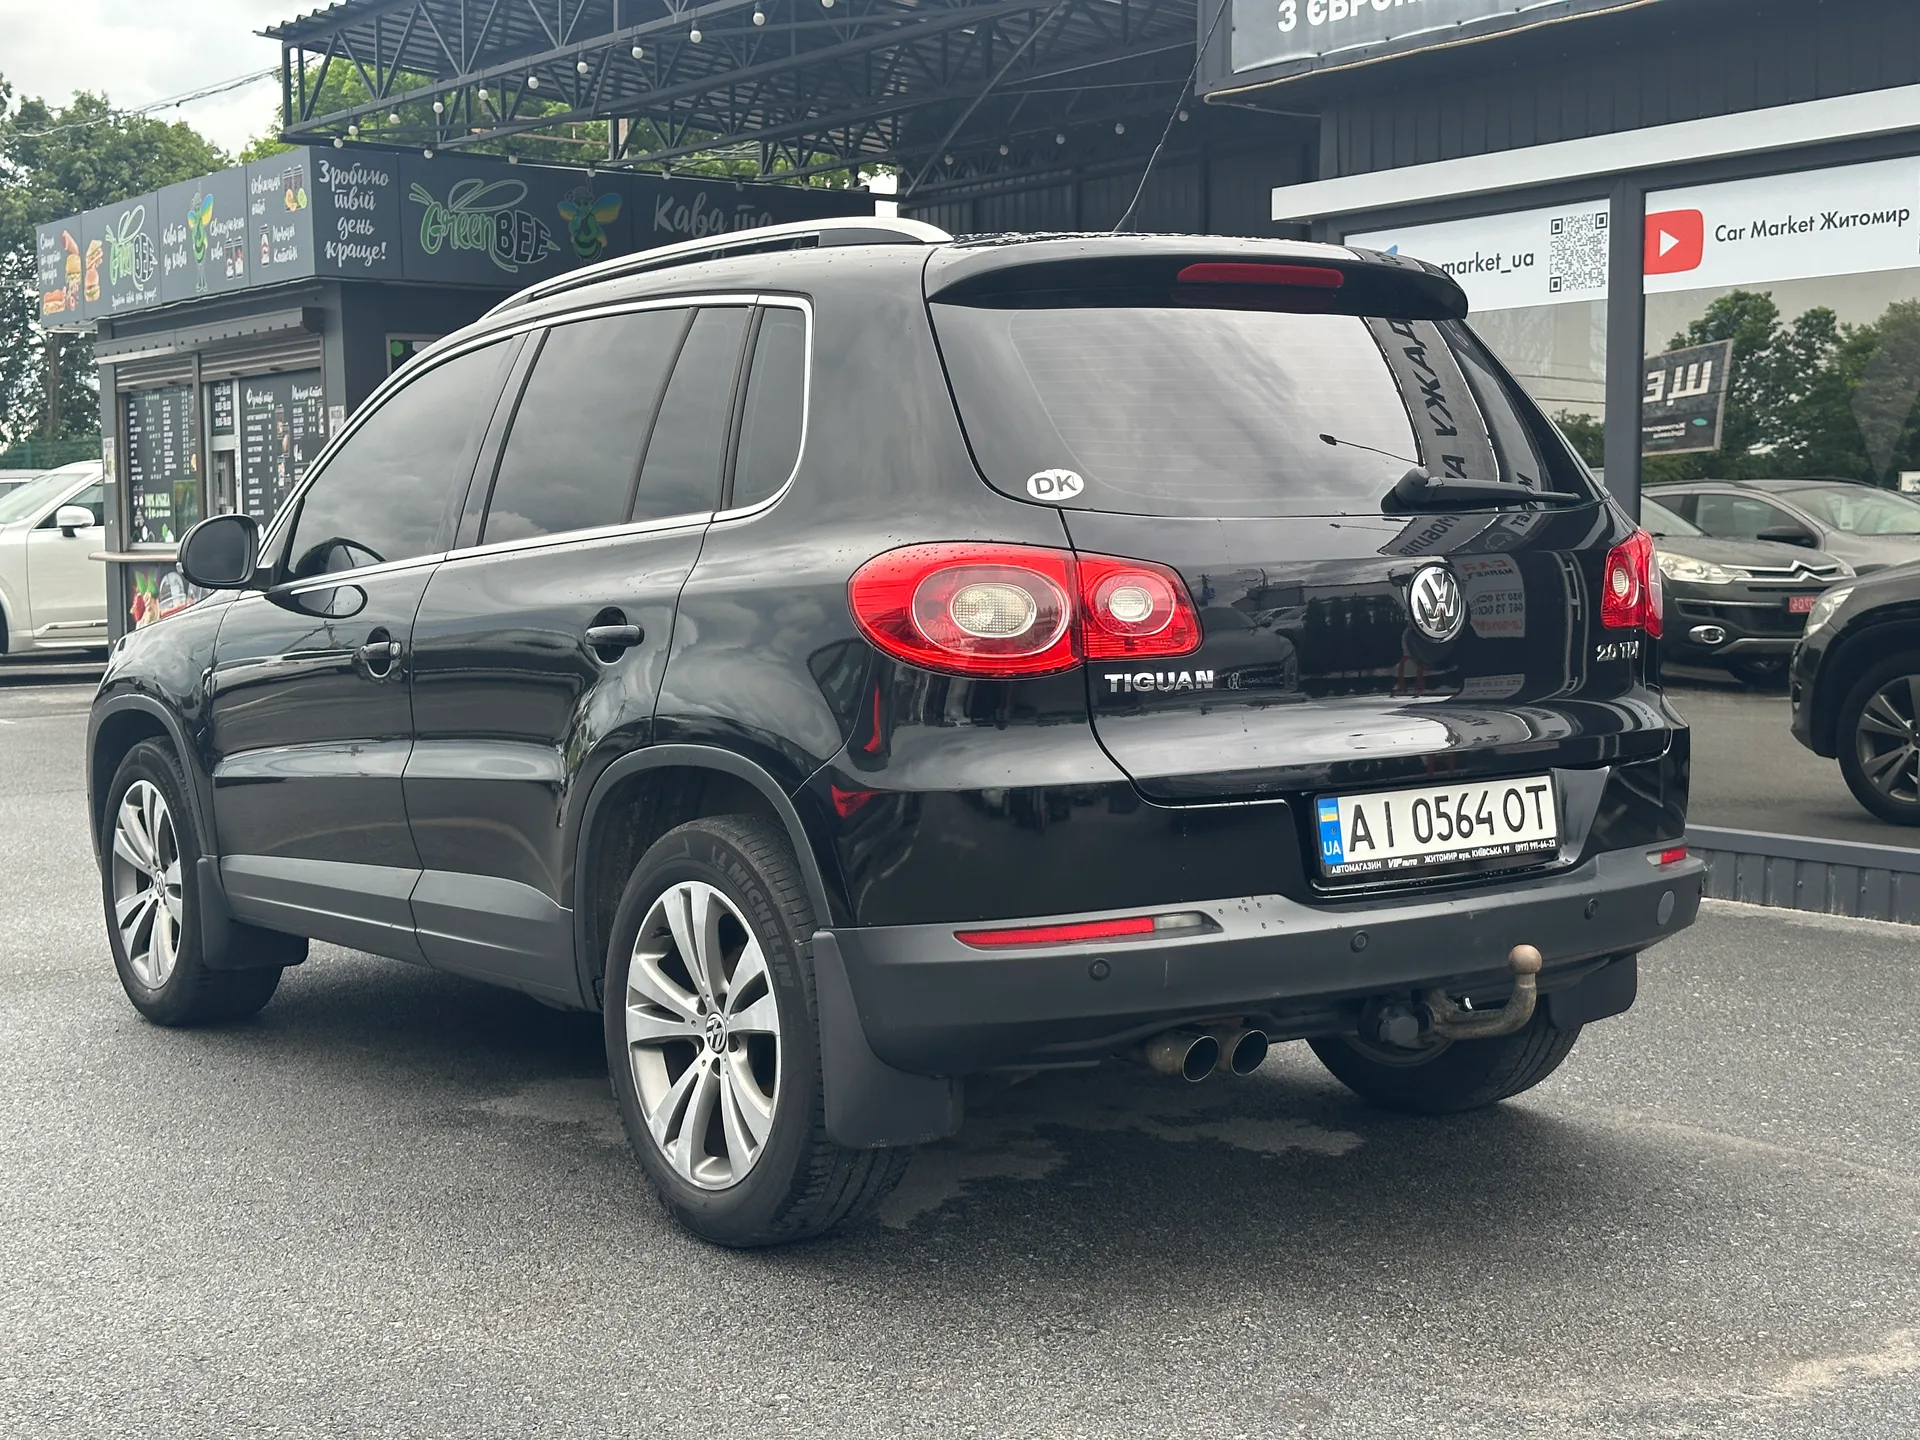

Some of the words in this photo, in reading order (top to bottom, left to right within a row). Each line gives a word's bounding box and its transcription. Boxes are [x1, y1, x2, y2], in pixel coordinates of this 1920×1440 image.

[319, 160, 389, 192] Зробимо
[334, 185, 377, 211] твій
[653, 191, 728, 238] Кава
[1714, 221, 1745, 244] Car
[1750, 215, 1814, 239] Market
[1819, 208, 1910, 231] Житомир
[337, 216, 375, 240] день
[324, 241, 387, 268] краще!
[1034, 474, 1078, 494] DK
[1104, 670, 1214, 693] TIGUAN
[1412, 790, 1495, 844] 0564
[1503, 784, 1548, 832] OT
[1323, 841, 1342, 856] UA
[1331, 861, 1382, 874] АВТОМАГАЗИН
[1423, 851, 1458, 863] ЖИТОМИР
[727, 861, 796, 988] MICHELIN
